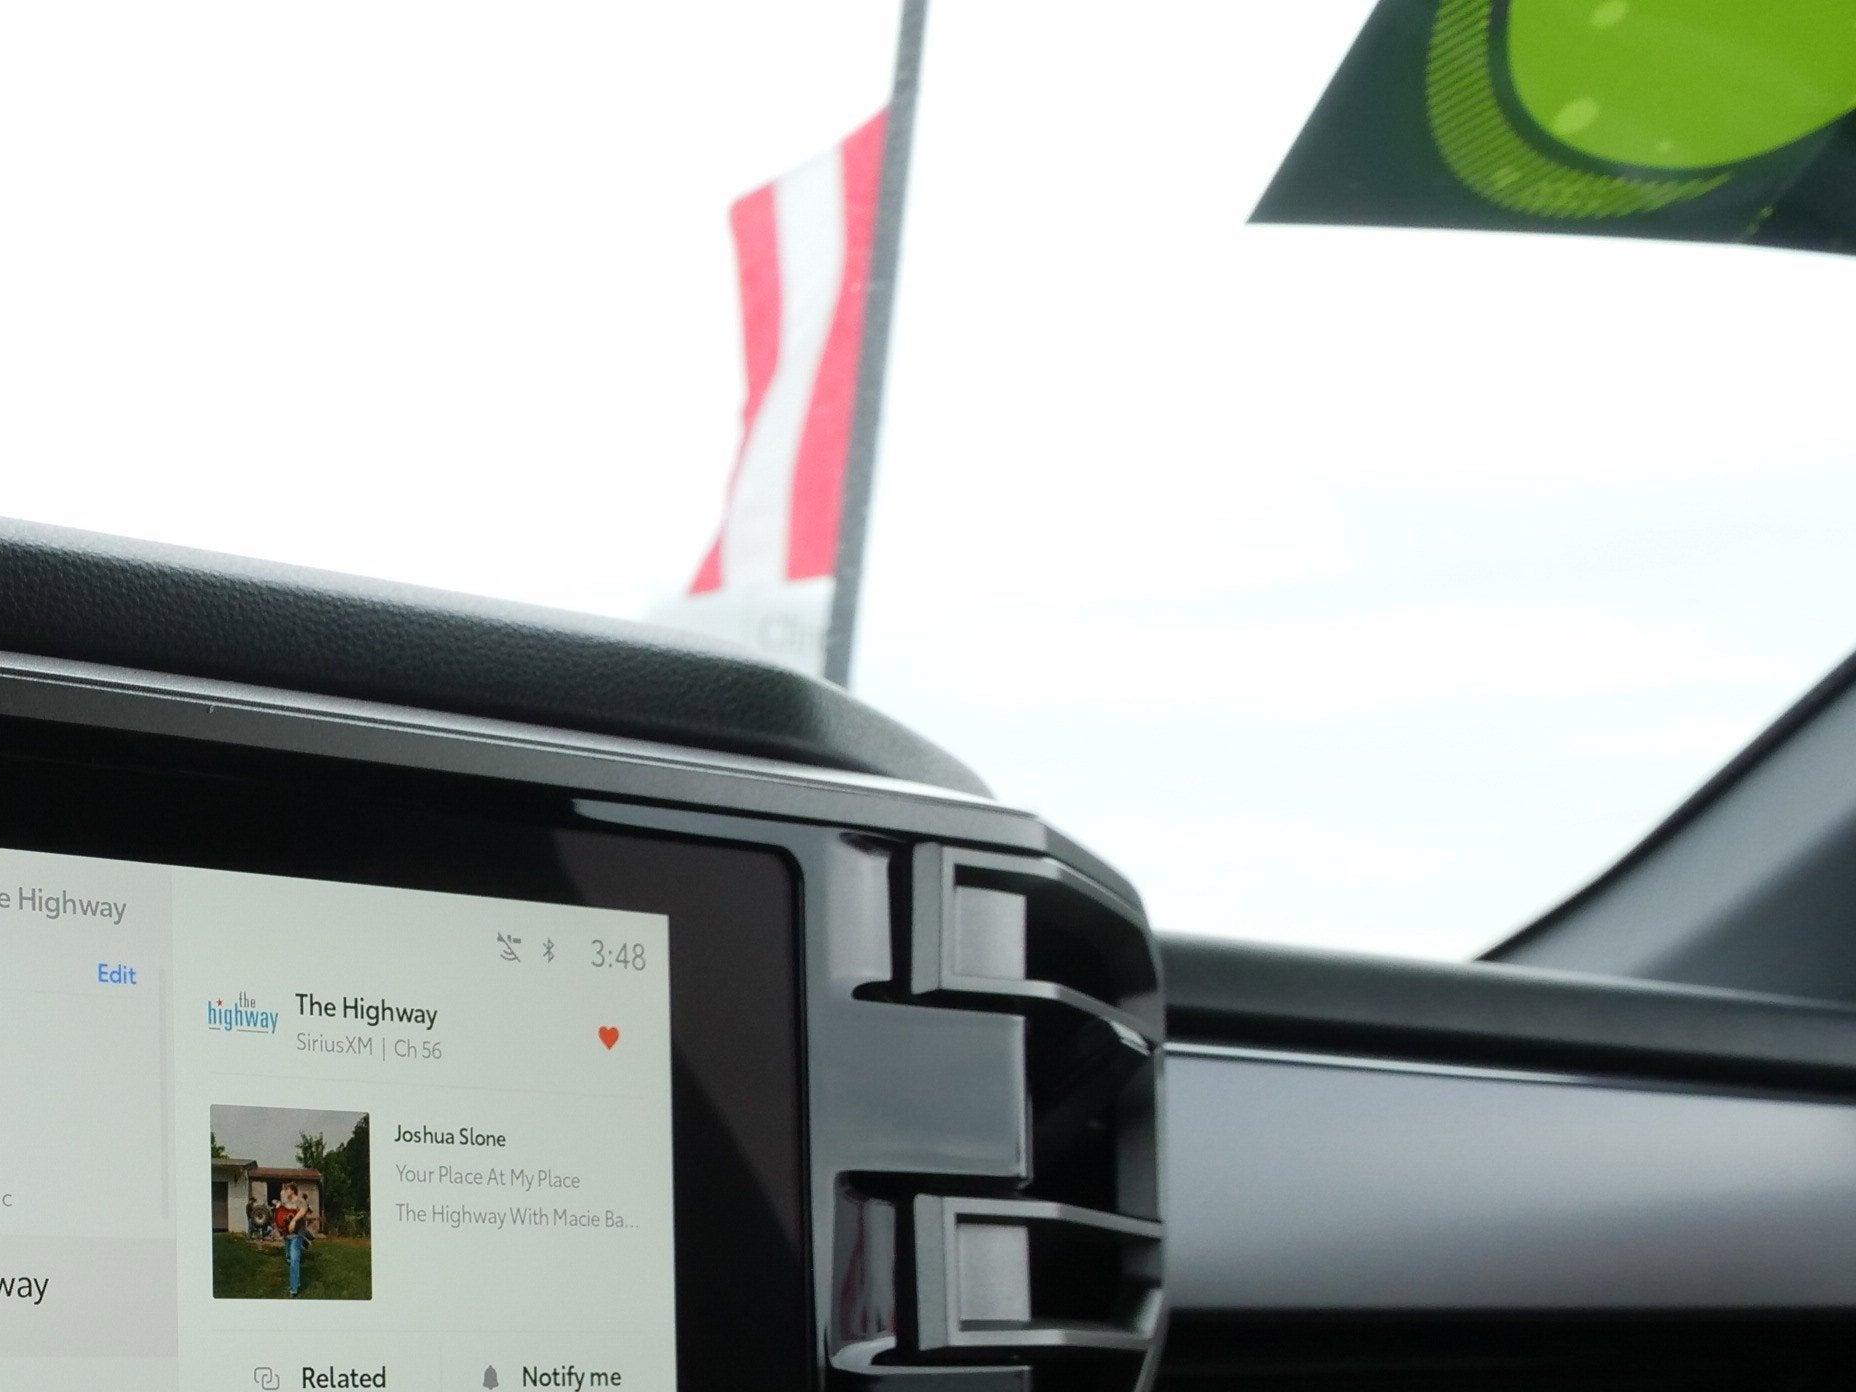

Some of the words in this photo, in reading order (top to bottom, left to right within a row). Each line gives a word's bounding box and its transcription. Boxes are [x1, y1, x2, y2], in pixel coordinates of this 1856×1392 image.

[18, 887, 127, 925] Highway
[591, 939, 646, 971] 3:48
[98, 963, 137, 986] Edit
[239, 991, 256, 1008] the
[295, 993, 336, 1017] The
[343, 997, 438, 1030] Highway
[208, 1000, 279, 1034] highway
[296, 1032, 373, 1056] SiriusXM
[394, 1039, 417, 1058] Ch
[422, 1041, 442, 1060] 56
[394, 1125, 455, 1145] Joshua
[459, 1128, 506, 1147] Slone
[395, 1164, 434, 1183] Your
[439, 1165, 483, 1185] Place
[487, 1168, 506, 1186] At
[511, 1169, 534, 1192] My
[538, 1170, 580, 1188] Place
[395, 1203, 427, 1222] The
[433, 1204, 506, 1229] Highway
[510, 1207, 548, 1226] With
[554, 1209, 600, 1228] Macie
[605, 1210, 640, 1228] Ba...
[302, 1366, 386, 1389] Related
[522, 1365, 586, 1392] Notify
[590, 1370, 622, 1387] me
